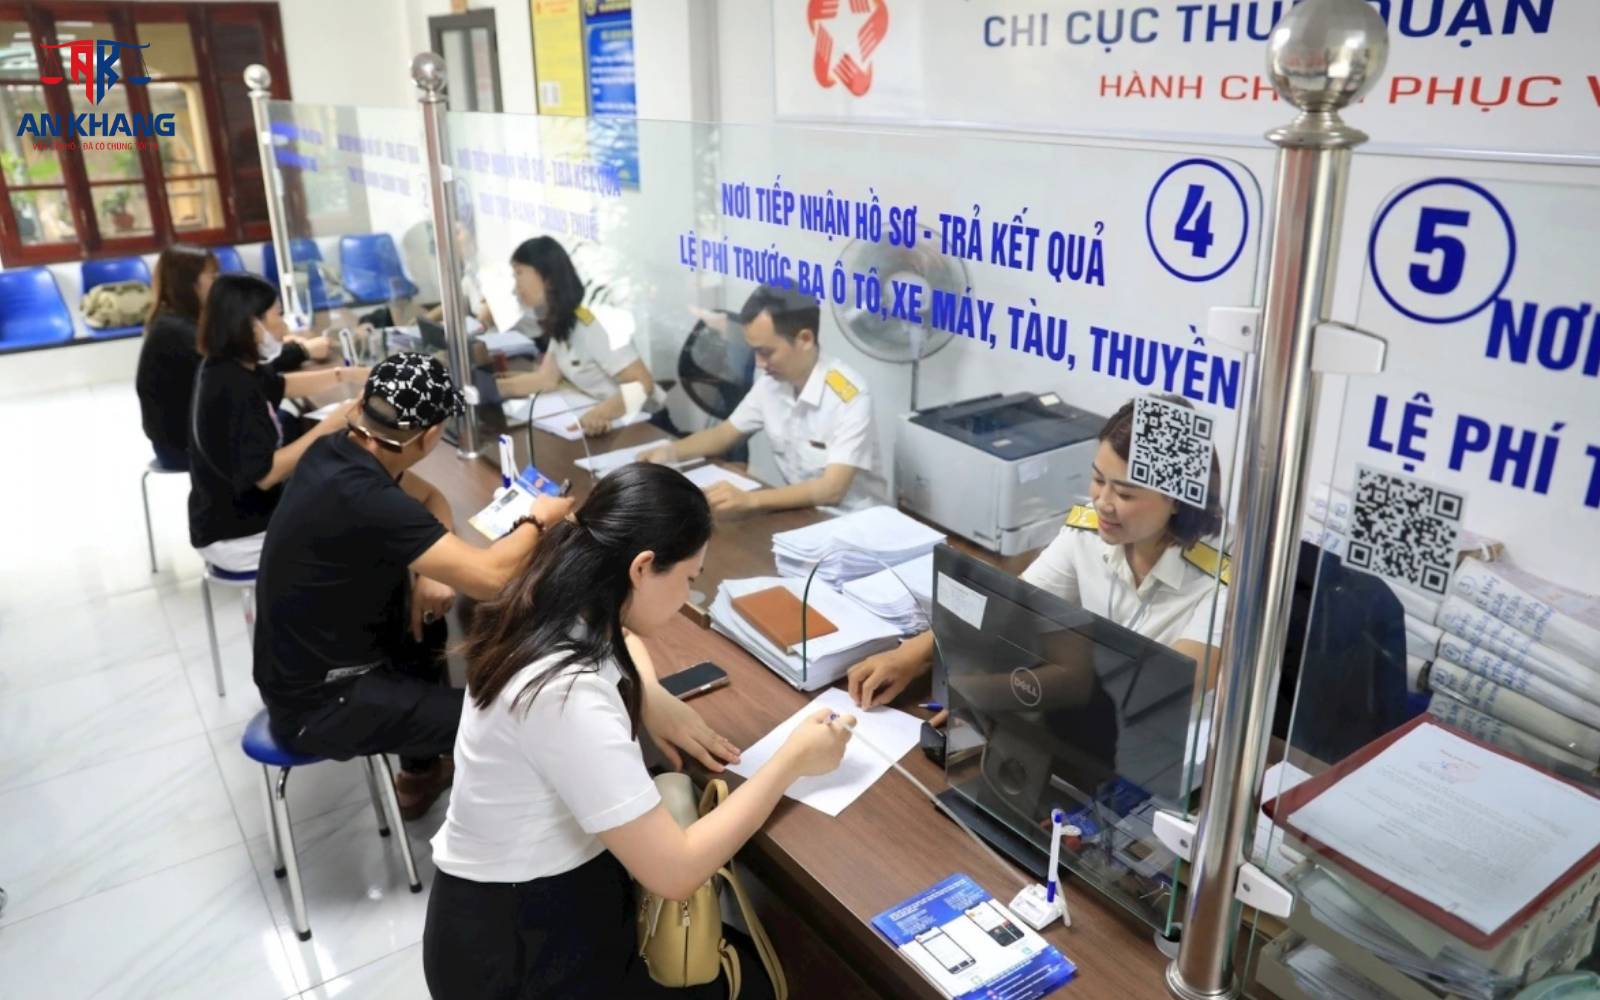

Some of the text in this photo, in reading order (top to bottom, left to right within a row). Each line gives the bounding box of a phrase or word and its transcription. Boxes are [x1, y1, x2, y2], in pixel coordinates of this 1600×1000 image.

[983, 13, 1048, 47] CHI
[1066, 7, 1160, 53] CỤC
[1177, 0, 1301, 43] THU
[1099, 70, 1203, 99] HÀNH
[1388, 76, 1562, 113] PHỤC
[721, 182, 751, 220] NƠI
[755, 174, 796, 227] TIẾP
[799, 189, 850, 242] NHẬN
[855, 187, 883, 243] HỒ
[888, 206, 918, 249] SƠ
[938, 203, 984, 263] TRẢ
[990, 207, 1040, 273] KẾT
[1046, 220, 1106, 288] QUẢ
[1173, 183, 1215, 259] 4
[1408, 206, 1471, 295] 5
[679, 230, 699, 273] LỆ
[701, 235, 729, 276] PHÍ
[733, 243, 792, 291] TRƯỚC
[798, 259, 826, 306] BẠ
[832, 260, 846, 305] Ô
[931, 286, 997, 350] MÁY,
[1007, 298, 1077, 372] TÀU,
[1089, 324, 1241, 411] THUYỀN
[1367, 391, 1434, 473] LỆ
[1448, 421, 1566, 496] PHÍ
[1014, 675, 1038, 697] DELL
